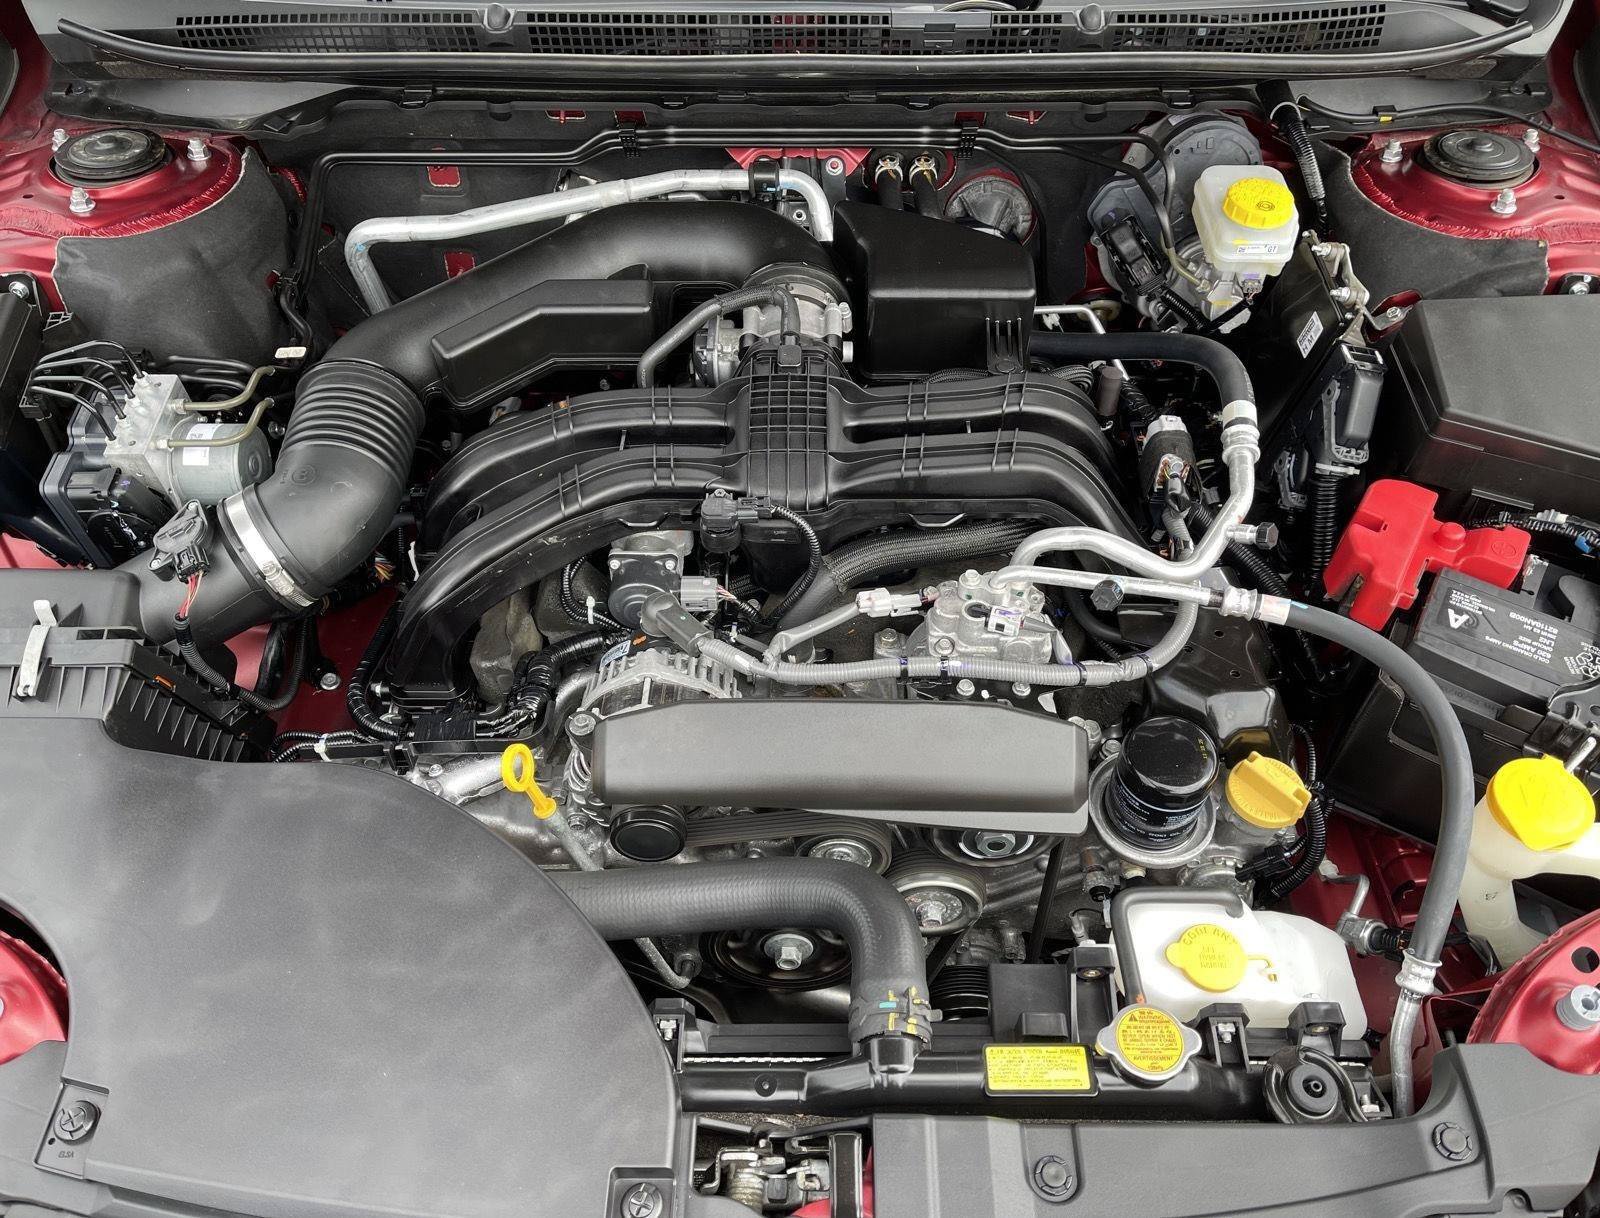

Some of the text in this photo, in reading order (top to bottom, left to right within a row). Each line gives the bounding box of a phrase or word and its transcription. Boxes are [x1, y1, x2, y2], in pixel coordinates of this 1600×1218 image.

[1448, 608, 1469, 629] A
[1484, 635, 1501, 644] AMPS
[1538, 636, 1554, 646] LN2
[1512, 639, 1536, 652] AMPS
[1532, 654, 1550, 663] COLD
